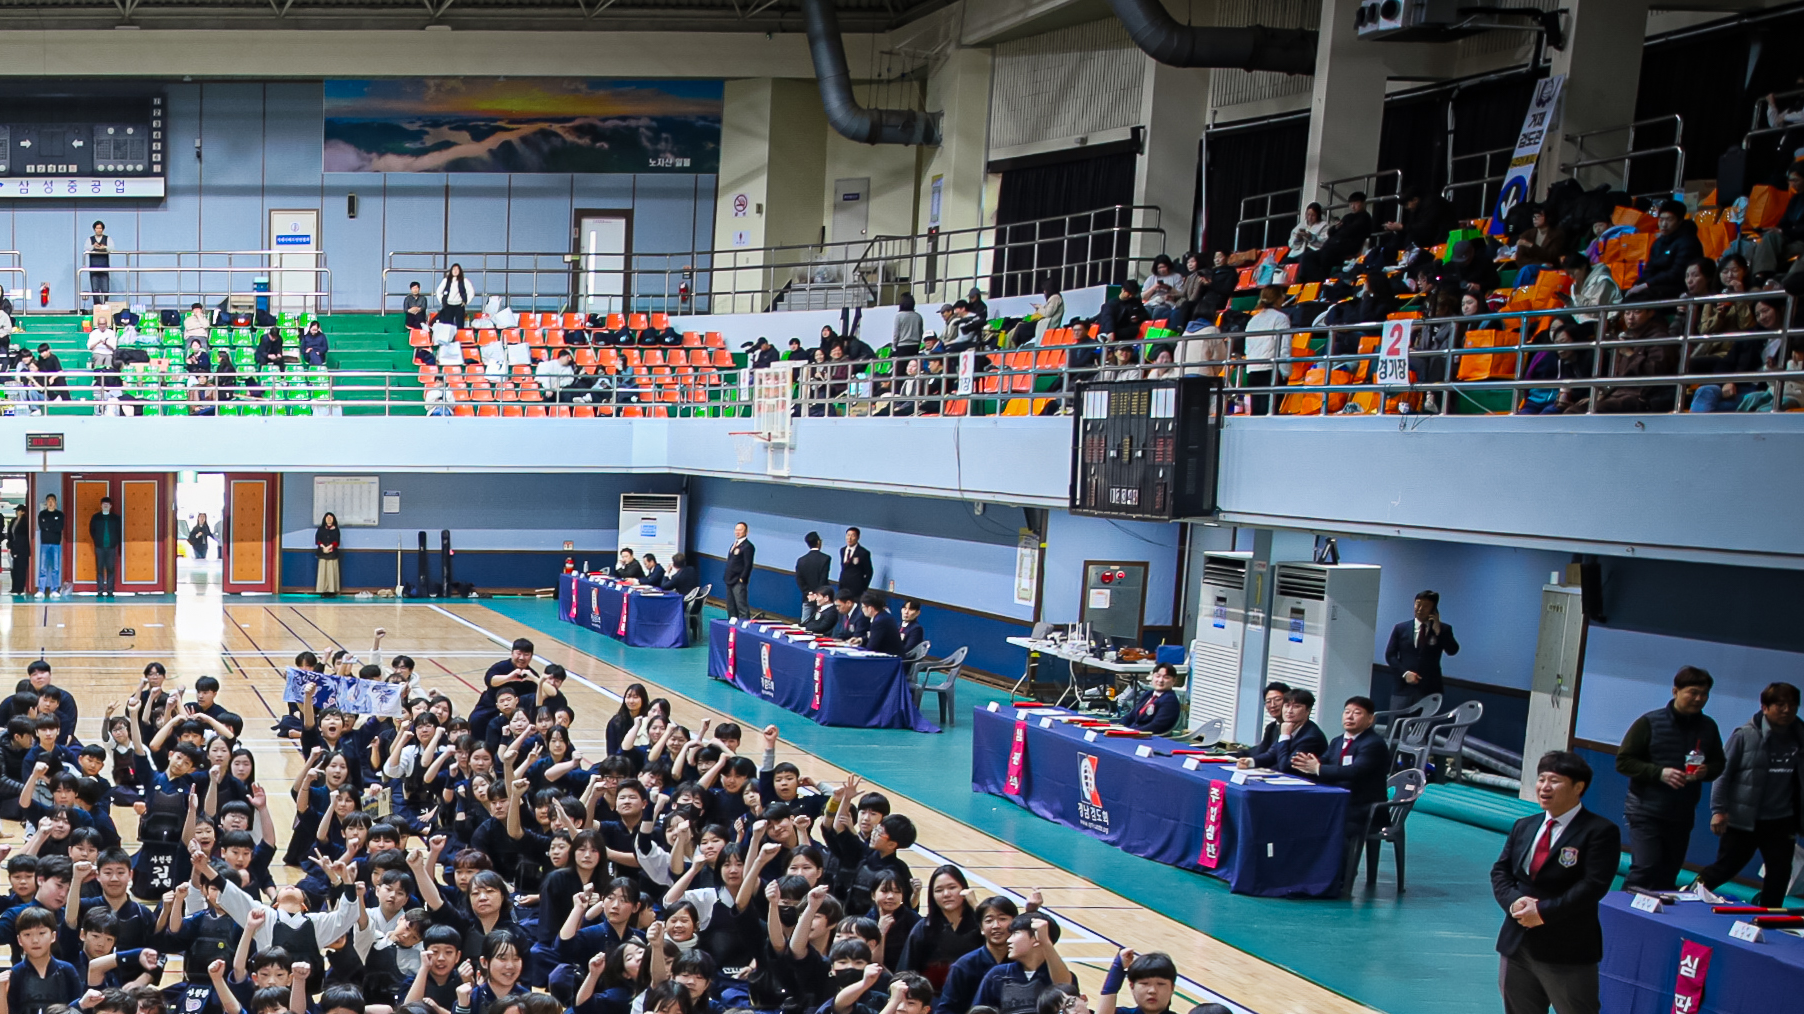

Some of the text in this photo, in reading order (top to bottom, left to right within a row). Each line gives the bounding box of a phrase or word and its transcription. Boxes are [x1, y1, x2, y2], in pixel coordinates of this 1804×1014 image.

[18, 179, 126, 194] 삼성중공업
[1386, 323, 1404, 356] 2
[1379, 359, 1407, 380] 경기장
[152, 865, 169, 879] 김
